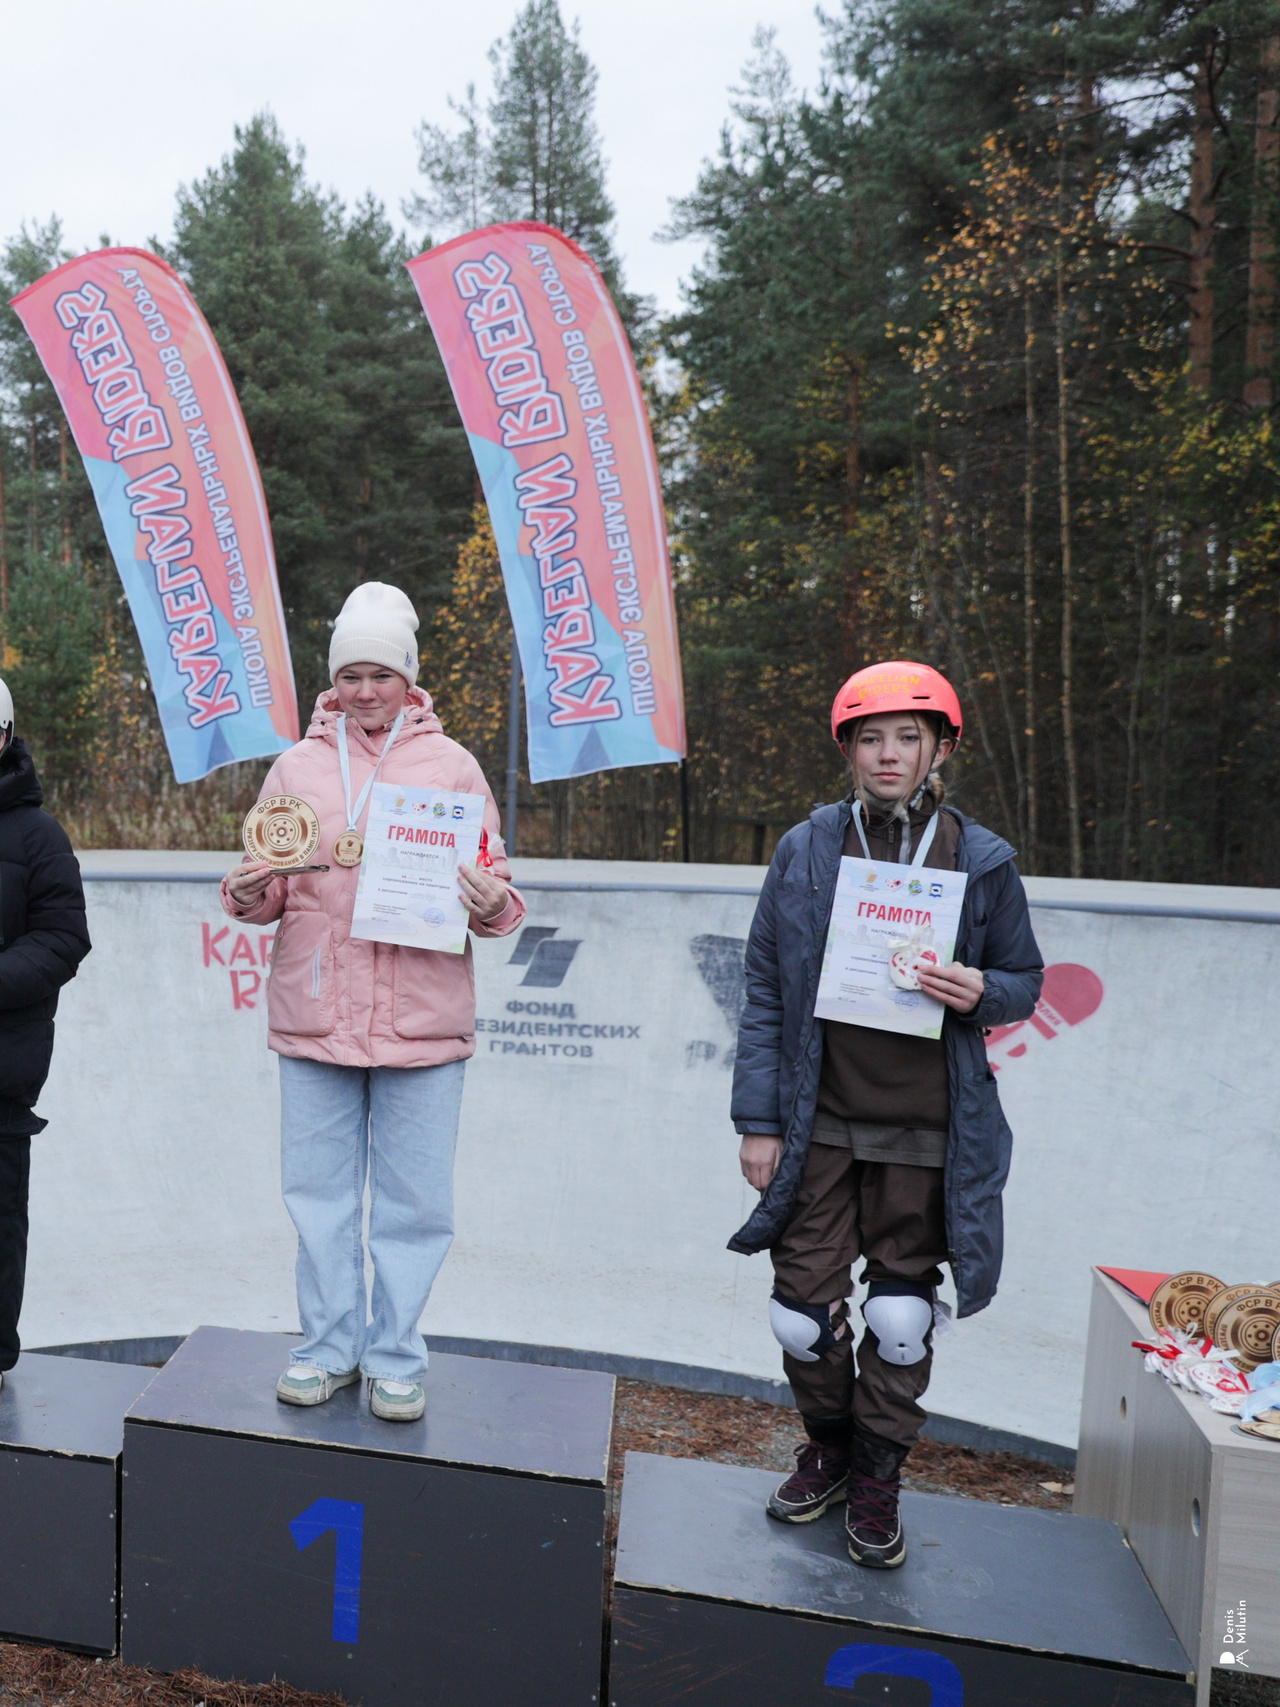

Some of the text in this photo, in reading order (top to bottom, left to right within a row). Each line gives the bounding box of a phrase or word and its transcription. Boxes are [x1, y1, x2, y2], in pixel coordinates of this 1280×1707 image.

[257, 798, 302, 814] ФСР В РК
[387, 825, 456, 848] ГРАМОТА
[400, 850, 439, 860] НАГРАЖДАЕТСЯ
[506, 1000, 577, 1019] ФОНД
[475, 1018, 642, 1039] ЕЗИДЕНТСКИХ
[489, 1040, 594, 1058] ГРАНТОВ
[1170, 1276, 1221, 1292] ФСР В РК
[1236, 1298, 1261, 1312] ФСР
[1265, 1299, 1273, 1307] В
[288, 1497, 365, 1644] 1
